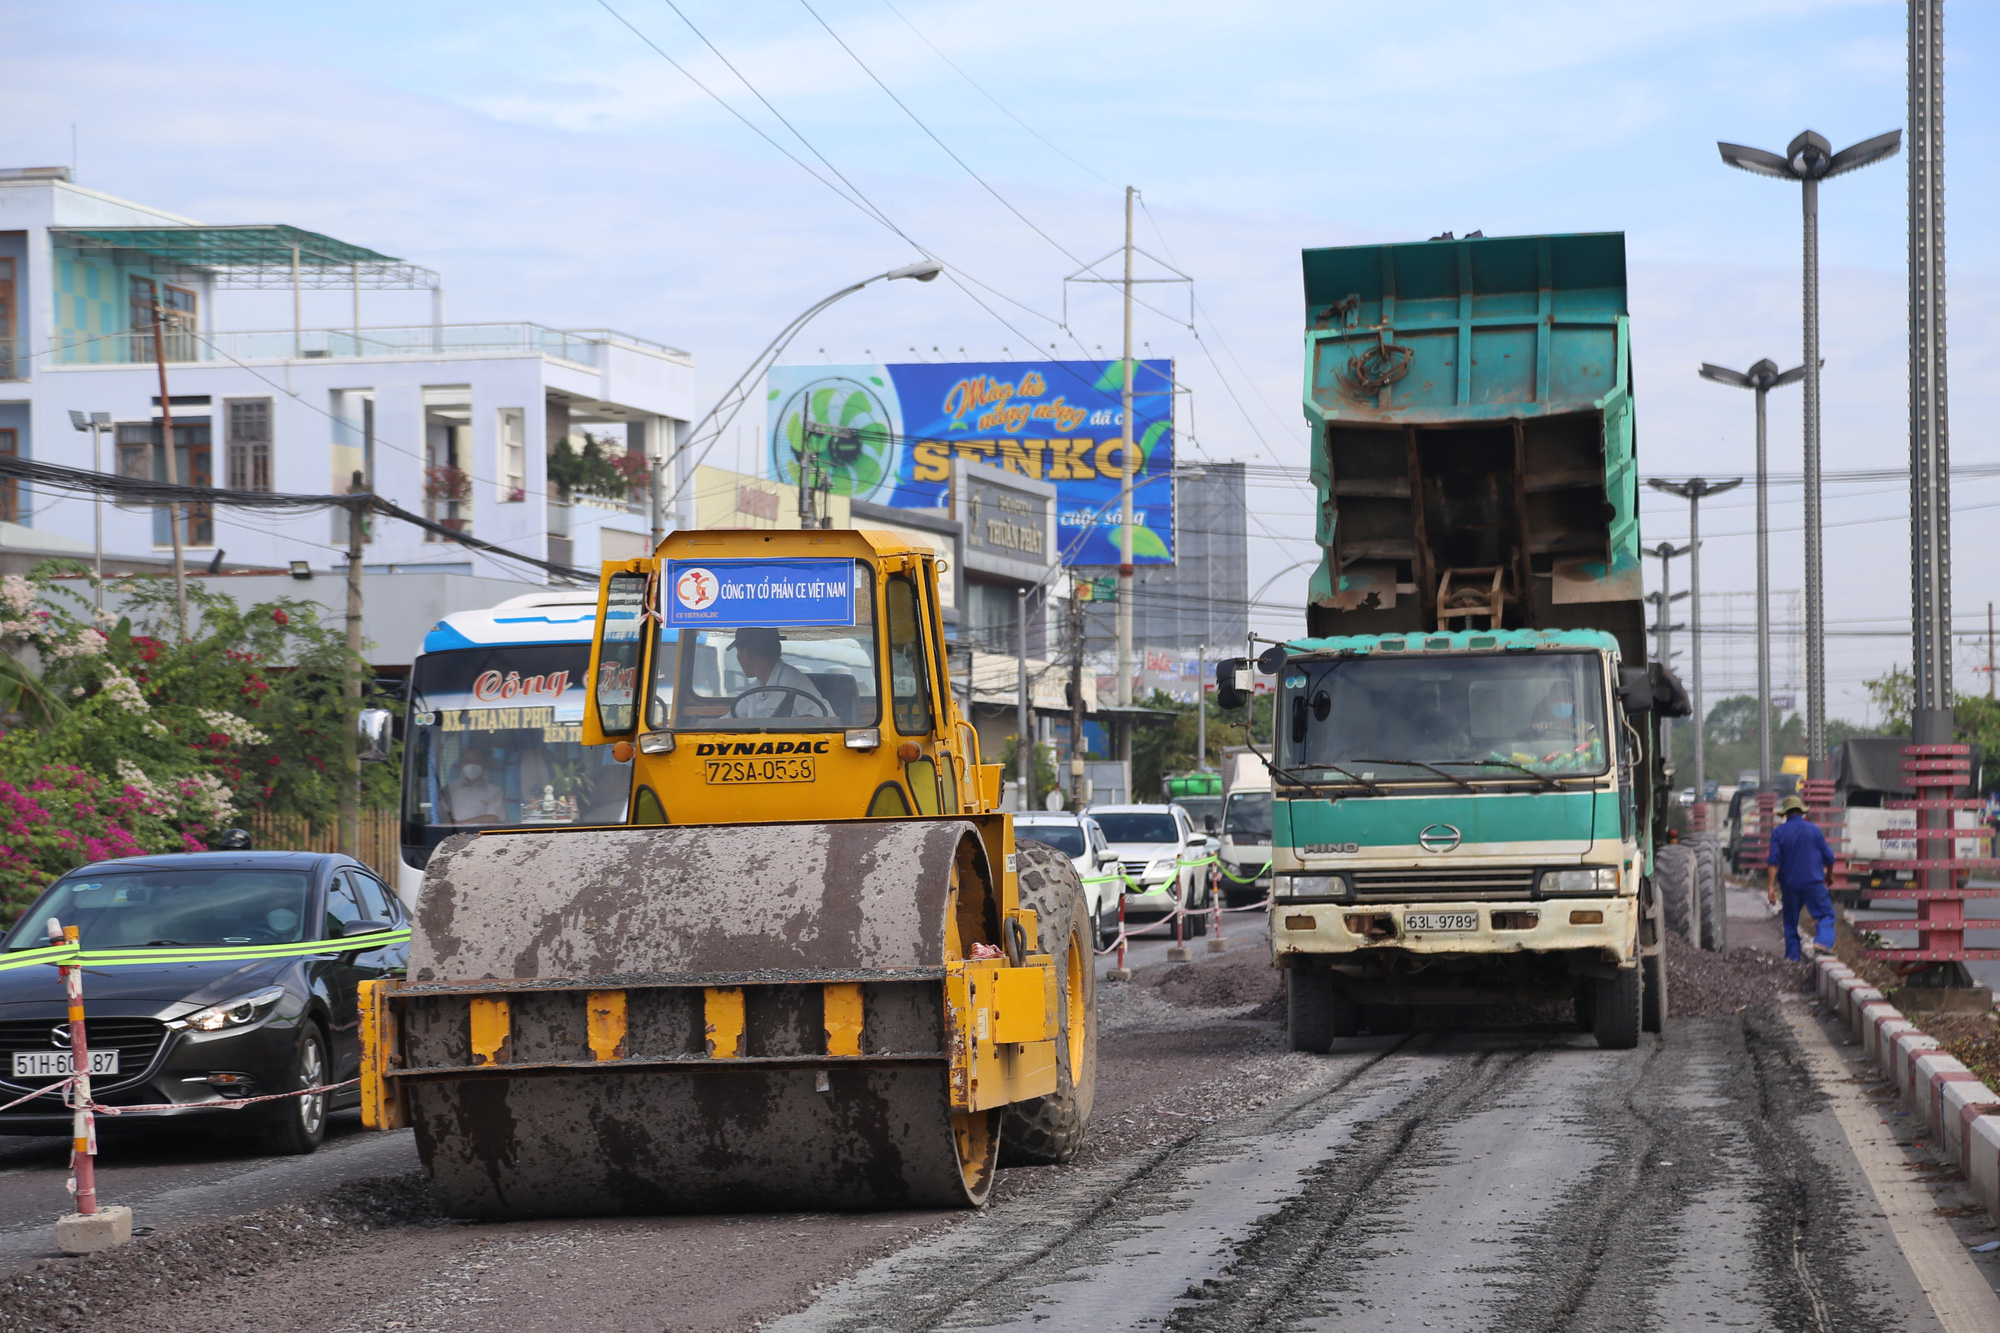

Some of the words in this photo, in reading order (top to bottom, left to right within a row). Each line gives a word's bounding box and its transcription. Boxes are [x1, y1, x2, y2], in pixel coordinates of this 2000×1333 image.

[944, 375, 1014, 420] Mùa
[1017, 372, 1046, 397] hè
[978, 399, 1031, 433] nắng
[1032, 396, 1087, 432] nóng
[1090, 410, 1112, 426] đã
[912, 437, 1144, 482] SENKO
[721, 579, 745, 600] CÔNG
[746, 583, 756, 599] TY
[757, 575, 769, 600] CỔ
[796, 583, 807, 599] CE
[808, 578, 825, 602] VIỆT
[826, 582, 846, 598] NAM
[473, 669, 573, 702] Công
[442, 710, 466, 732] BX.
[468, 708, 520, 734] THẠNH
[696, 741, 830, 756] DYNAPAC
[1304, 842, 1359, 854] HINO
